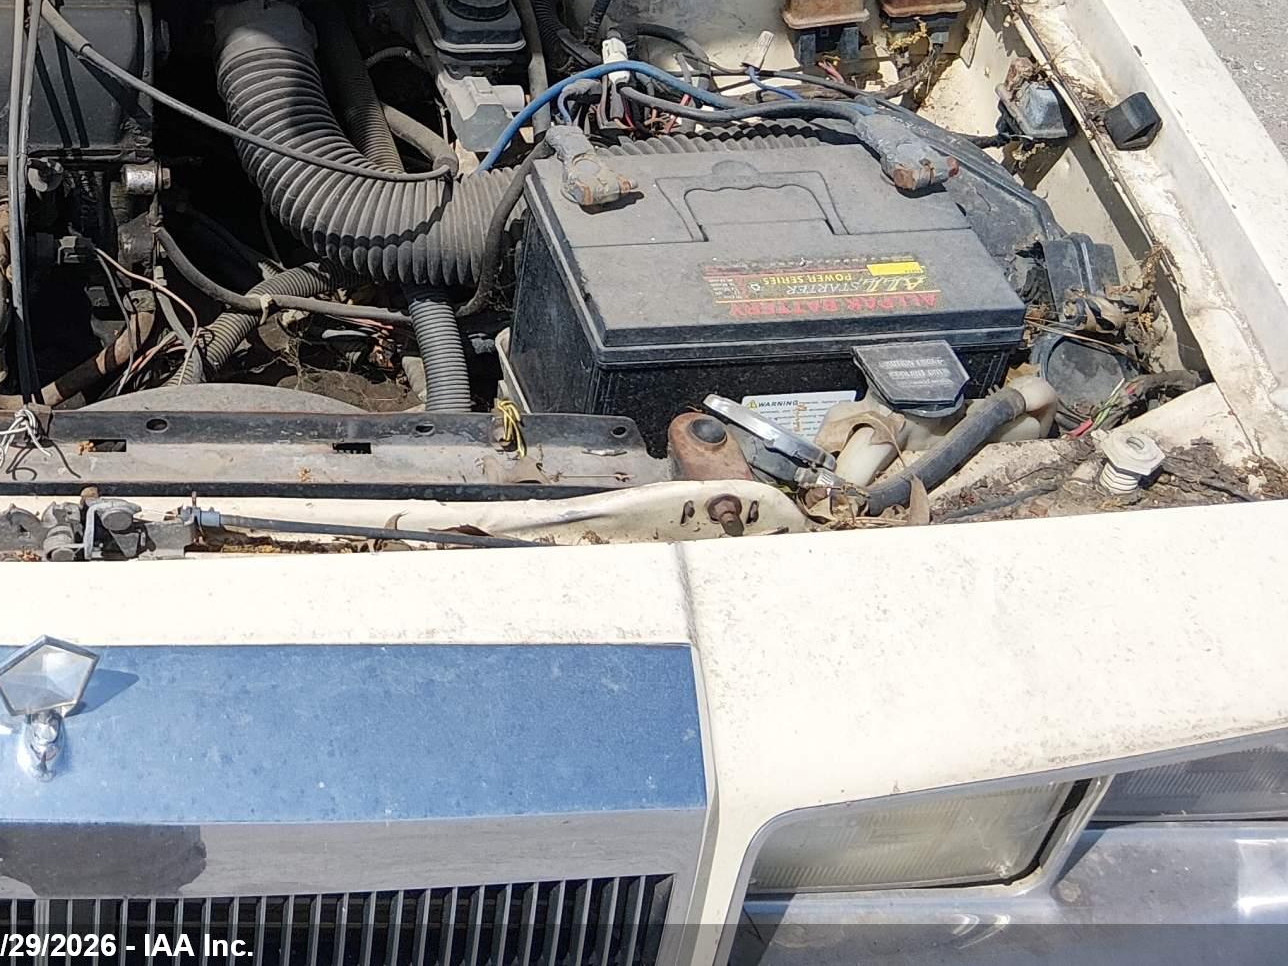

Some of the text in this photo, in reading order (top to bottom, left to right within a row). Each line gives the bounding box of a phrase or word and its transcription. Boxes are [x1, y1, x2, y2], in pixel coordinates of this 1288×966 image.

[762, 272, 852, 285] POWER SERIES
[786, 280, 860, 296] STARTER
[728, 298, 840, 317] BATTERY
[757, 399, 799, 409] WARNING
